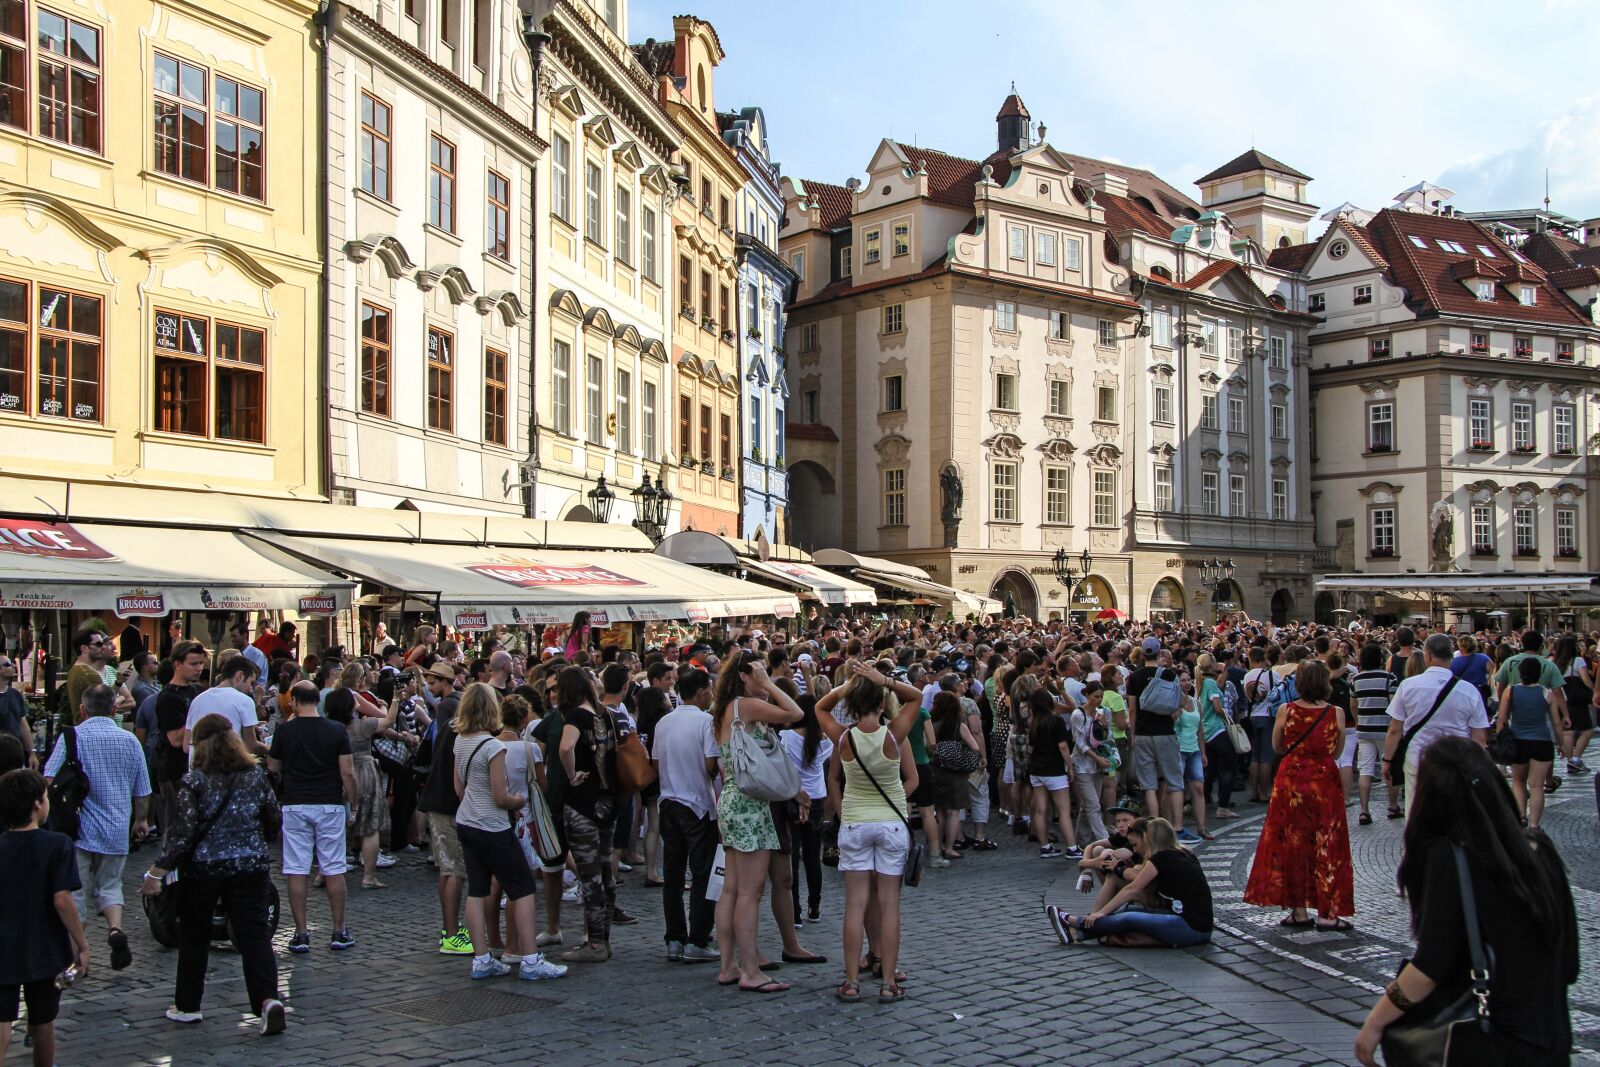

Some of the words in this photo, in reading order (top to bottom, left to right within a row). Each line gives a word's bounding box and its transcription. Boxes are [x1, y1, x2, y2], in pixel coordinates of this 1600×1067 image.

[156, 316, 177, 328] CON
[156, 325, 178, 337] CERT
[0, 528, 88, 551] ICE
[40, 600, 74, 608] NEGRO
